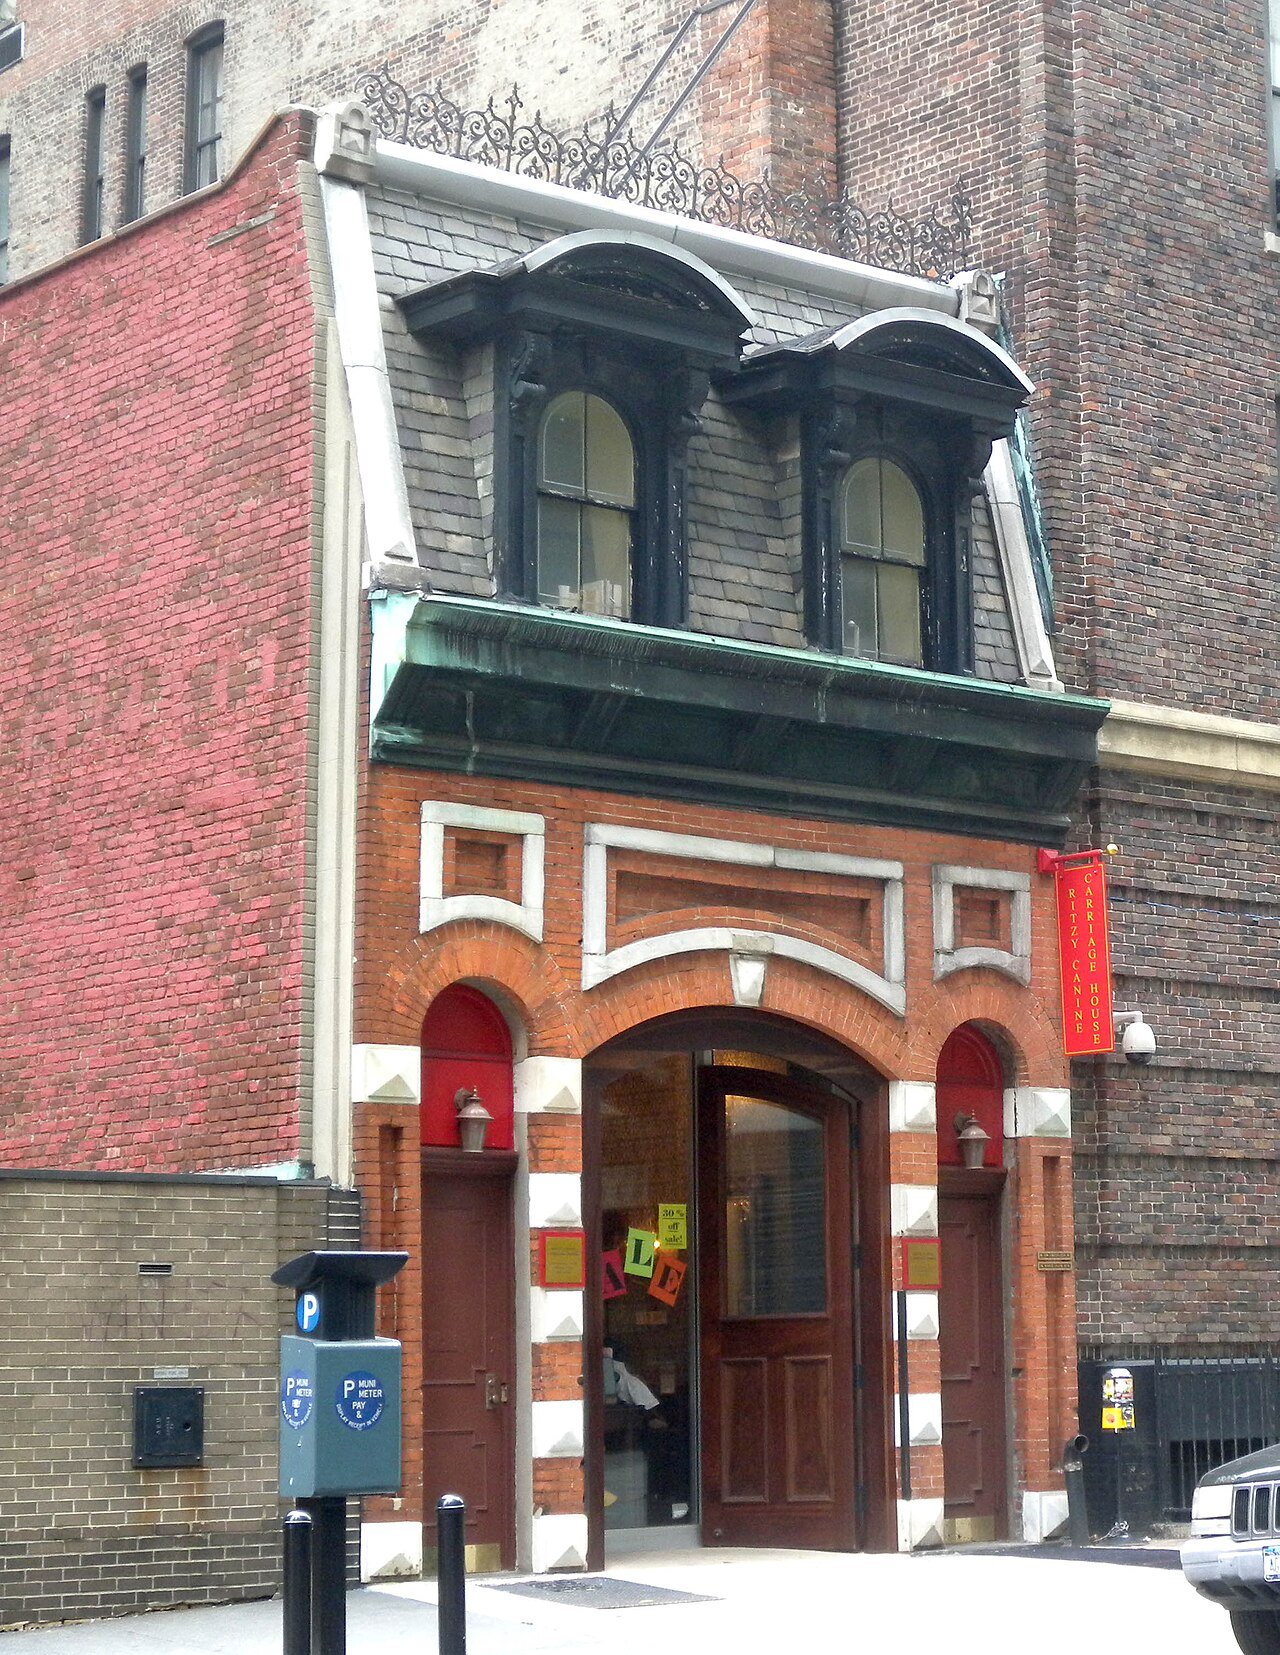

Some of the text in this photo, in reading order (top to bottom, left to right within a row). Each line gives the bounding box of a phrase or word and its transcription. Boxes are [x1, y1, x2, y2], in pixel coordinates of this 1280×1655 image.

[1068, 888, 1083, 1034] RITZY CANINE
[1084, 873, 1101, 1044] CARRIAGE HOUSE
[662, 1209, 674, 1217] 30
[667, 1222, 680, 1230] off
[303, 1294, 318, 1330] P
[286, 1377, 295, 1396] P
[296, 1378, 309, 1387] MUNI
[358, 1379, 376, 1388] MUNI
[296, 1388, 313, 1397] METER
[343, 1379, 355, 1399] P
[358, 1389, 383, 1398] METER
[352, 1401, 366, 1410] PAY
[356, 1410, 362, 1419] &
